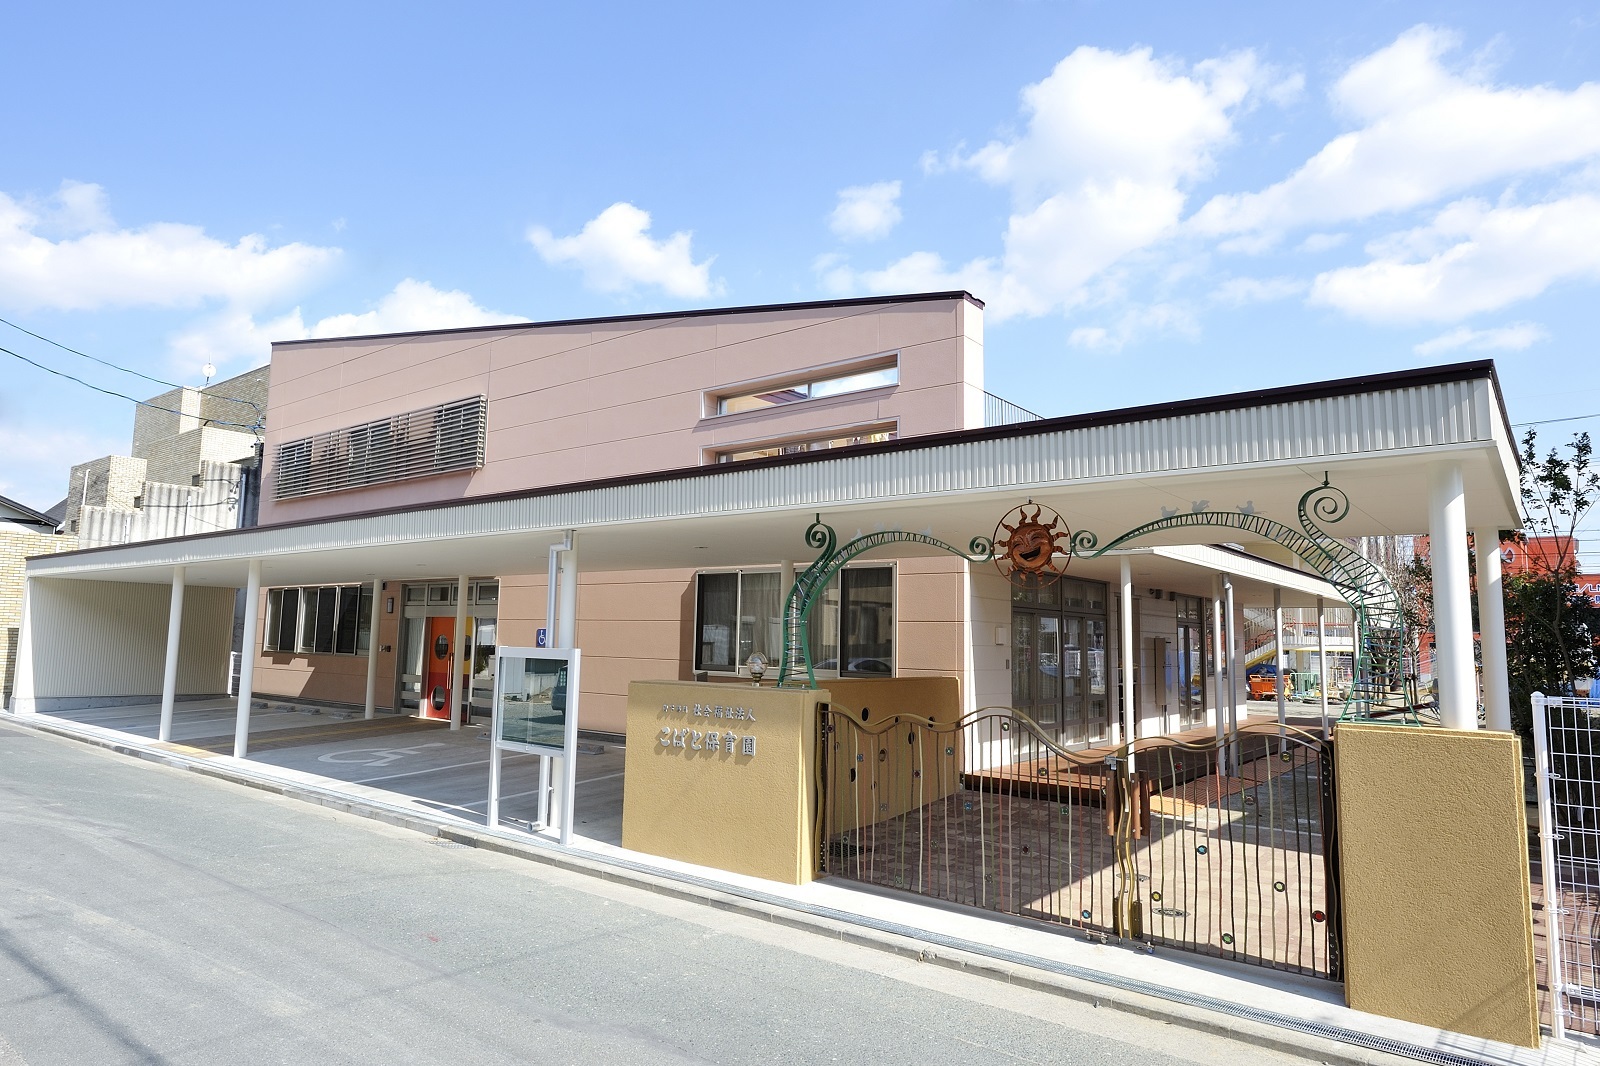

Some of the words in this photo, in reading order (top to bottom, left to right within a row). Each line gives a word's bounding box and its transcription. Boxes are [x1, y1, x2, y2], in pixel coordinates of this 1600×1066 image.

[660, 726, 756, 757] こばと保育園
